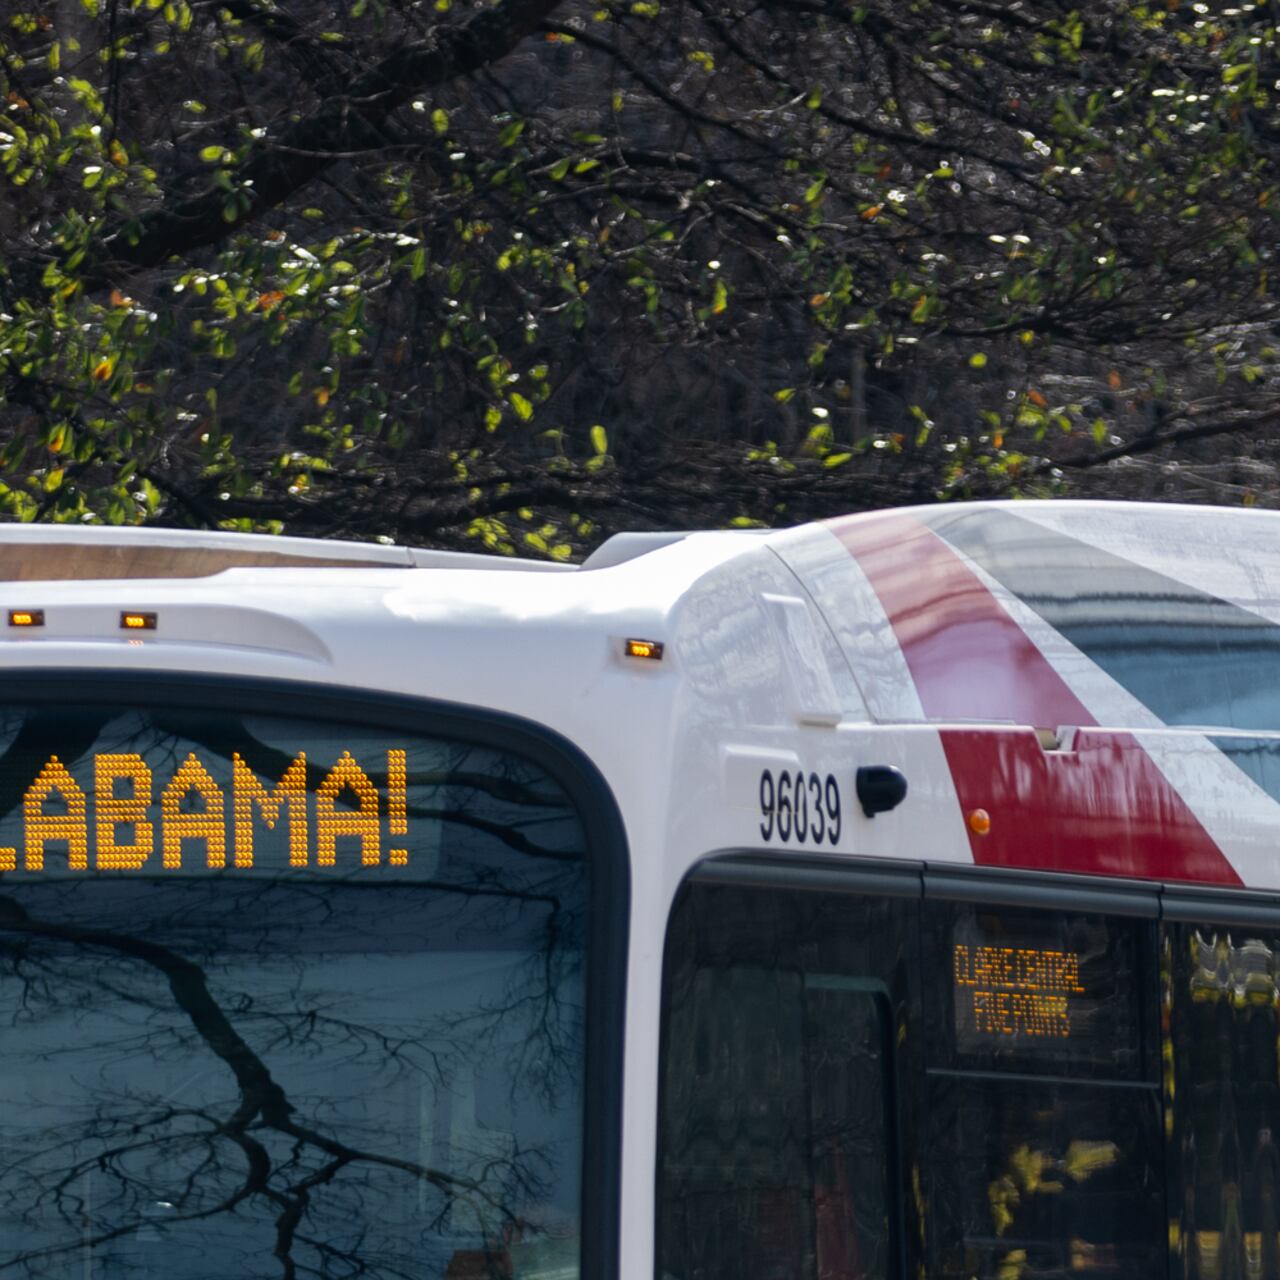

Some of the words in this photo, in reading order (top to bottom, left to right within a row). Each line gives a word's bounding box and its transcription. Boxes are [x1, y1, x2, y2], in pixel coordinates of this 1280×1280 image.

[759, 768, 842, 846] 96039
[954, 945, 1015, 988] CLARKE
[1015, 948, 1086, 994] CENTRAL
[973, 991, 1013, 1034] FIVE
[1013, 994, 1071, 1038] POINTS
